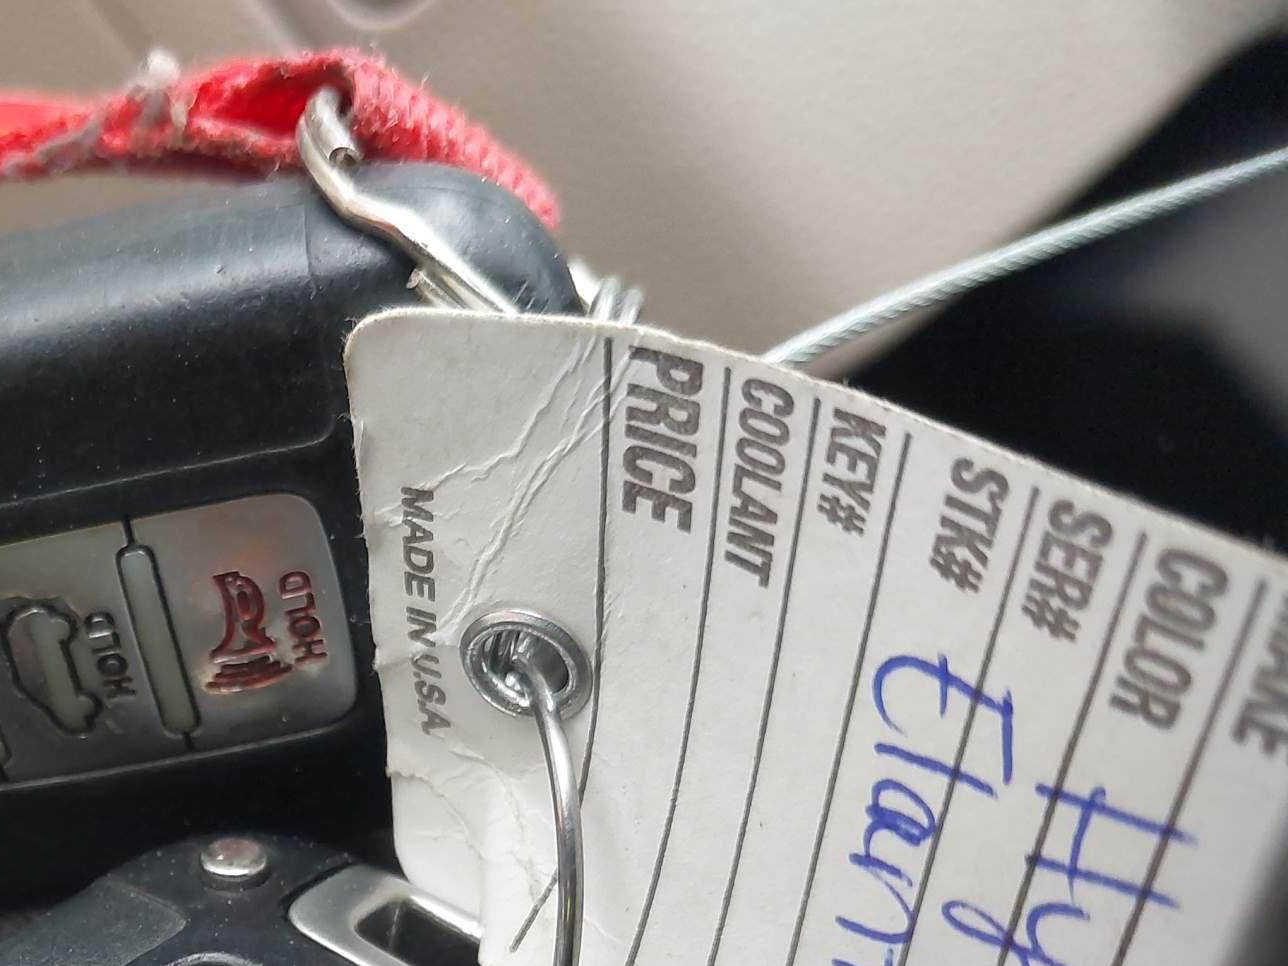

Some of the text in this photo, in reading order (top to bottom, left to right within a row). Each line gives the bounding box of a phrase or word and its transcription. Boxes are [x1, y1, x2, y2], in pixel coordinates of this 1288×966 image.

[621, 346, 704, 534] PRICE
[724, 377, 794, 589] COOLANT
[817, 406, 887, 537] KEY#
[400, 486, 436, 602] MADE
[929, 457, 1010, 593] STK#
[1022, 499, 1113, 643] SER#
[84, 611, 136, 698] HOLD
[278, 570, 327, 667] HOLD
[406, 606, 437, 649] IN
[1109, 547, 1229, 730] COLOR
